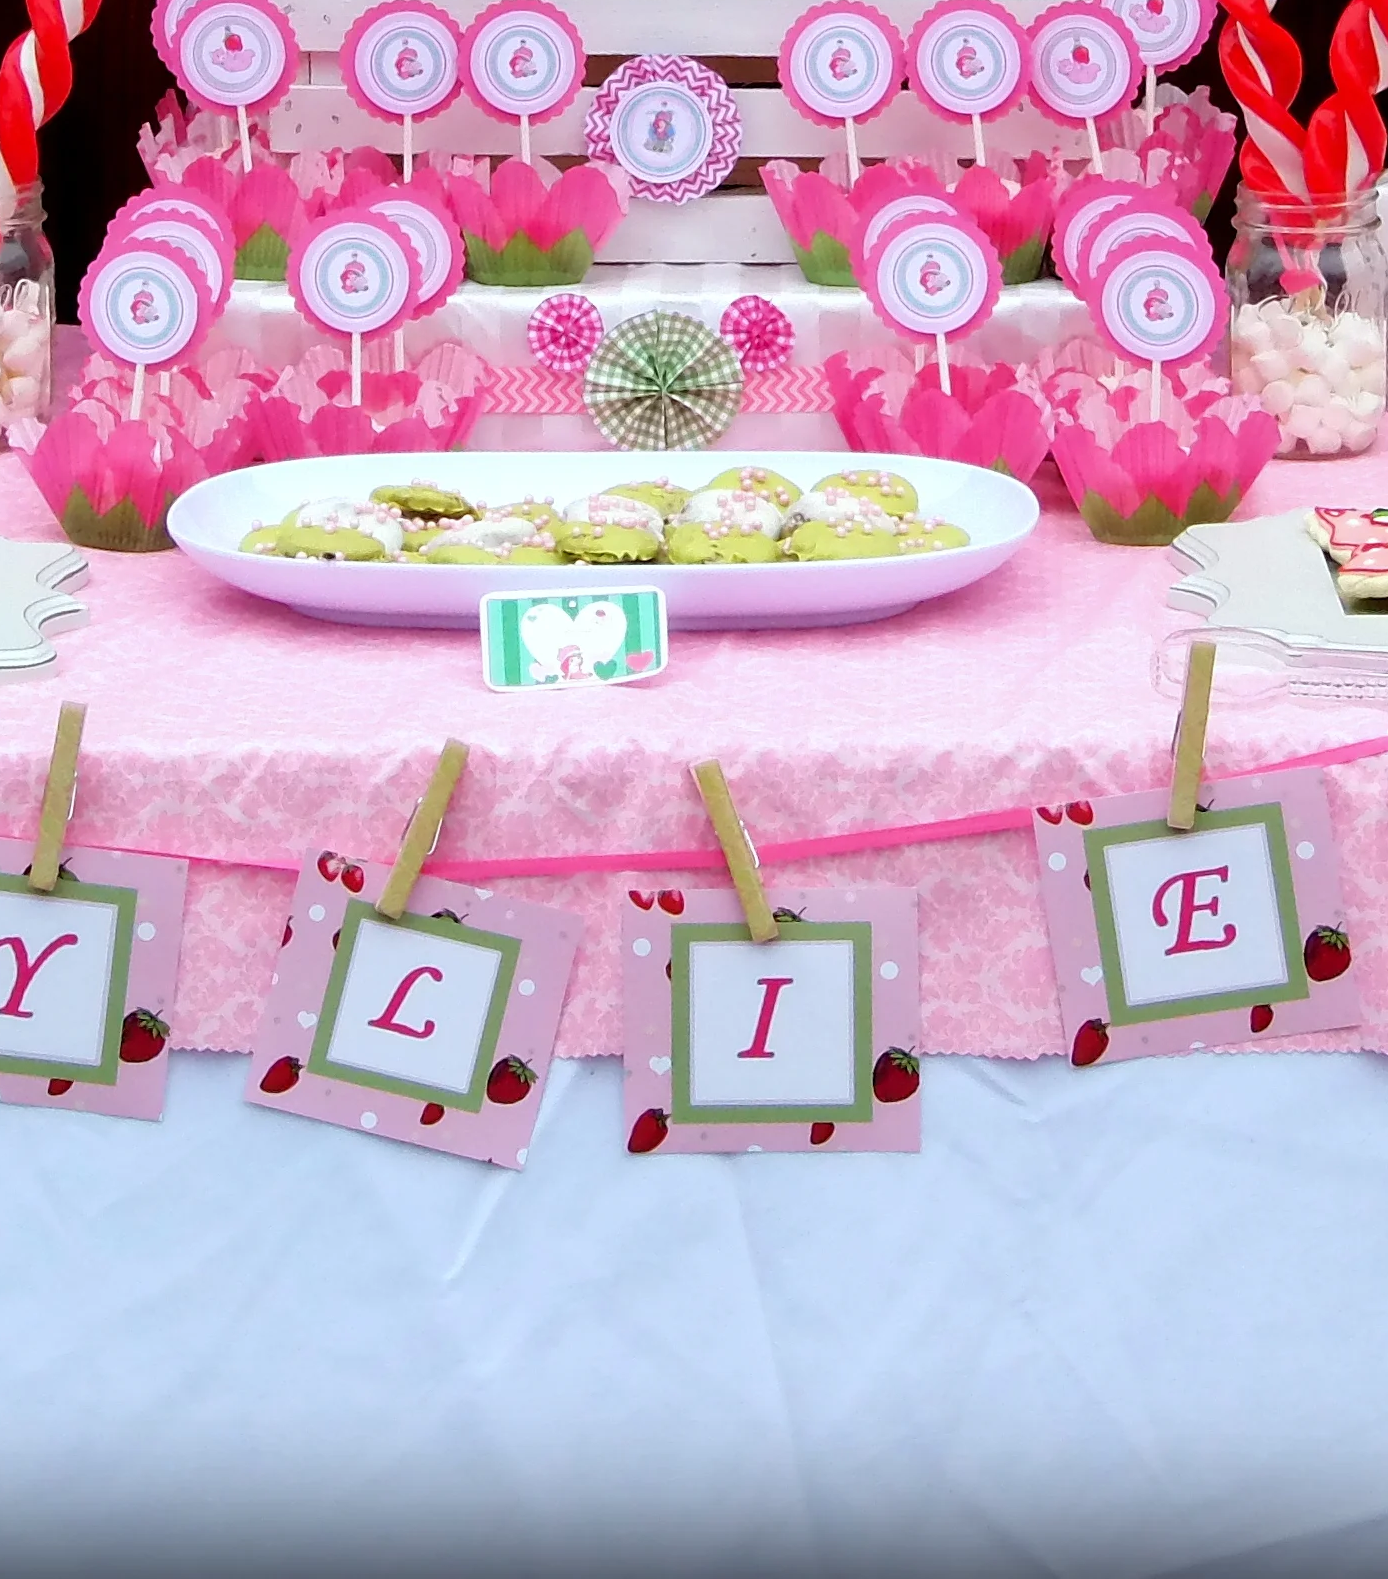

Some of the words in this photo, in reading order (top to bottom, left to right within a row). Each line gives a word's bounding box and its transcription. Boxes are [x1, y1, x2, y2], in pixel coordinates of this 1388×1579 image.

[370, 965, 445, 1041] L
[739, 976, 792, 1060] I
[1150, 865, 1239, 957] E
